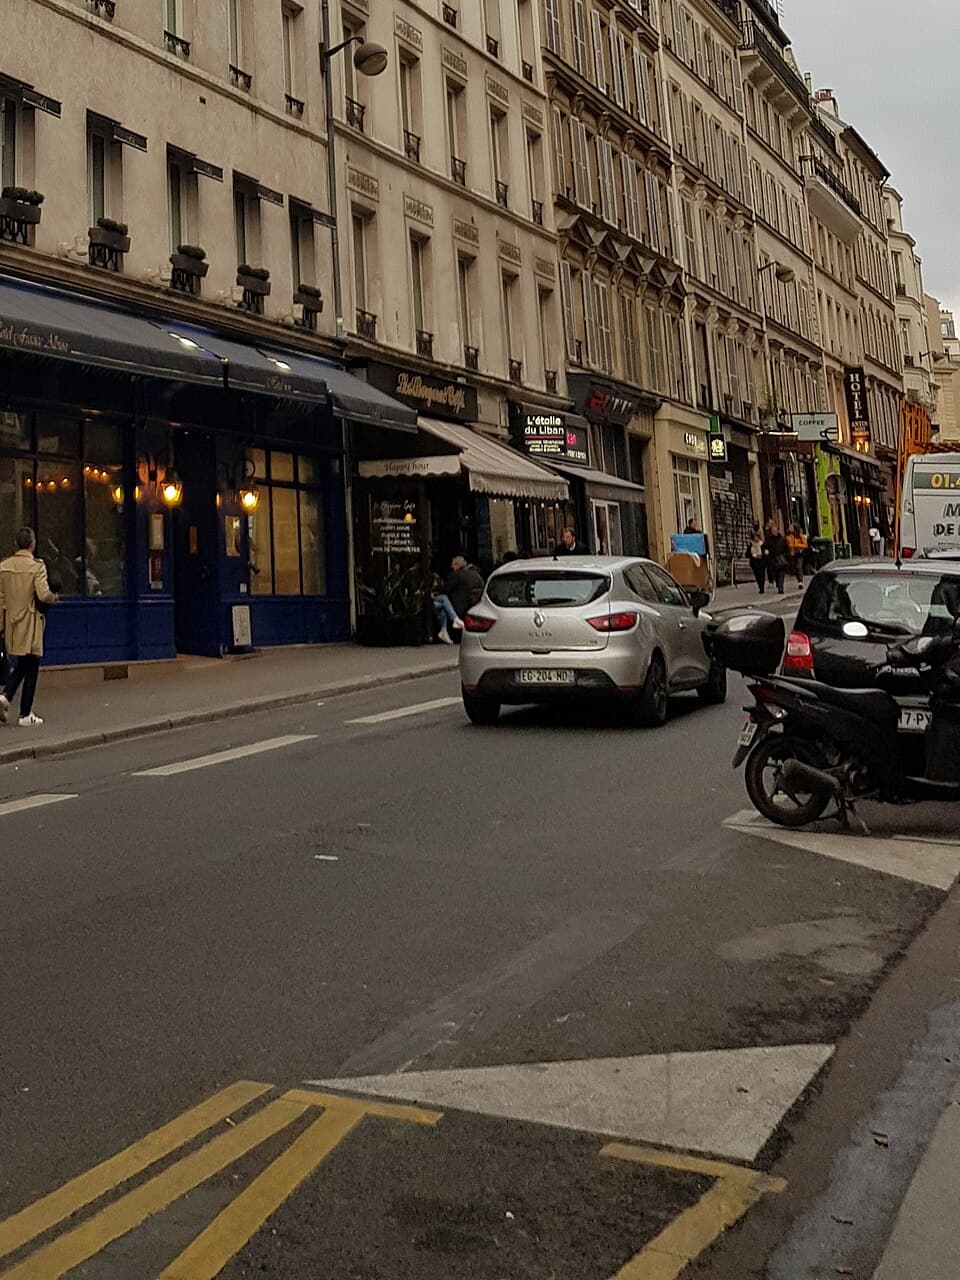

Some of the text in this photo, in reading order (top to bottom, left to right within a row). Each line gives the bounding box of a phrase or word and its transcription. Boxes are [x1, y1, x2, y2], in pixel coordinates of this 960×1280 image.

[849, 373, 863, 419] HOTEL
[527, 415, 561, 426] L'étoile
[524, 425, 564, 435] du Liban
[935, 523, 955, 536] DE
